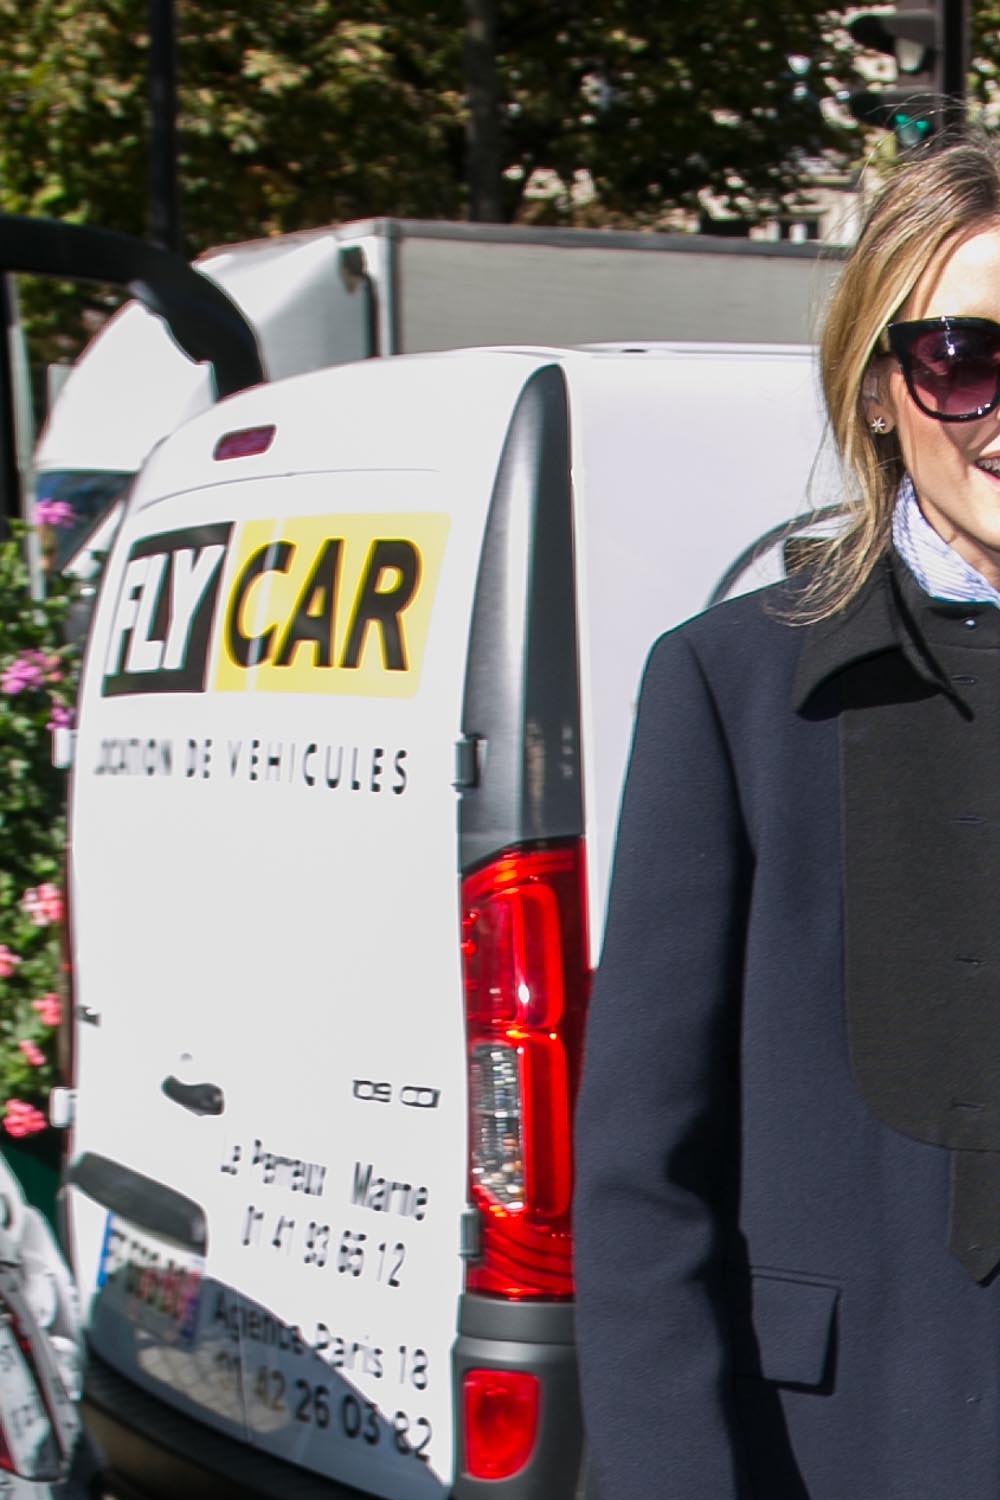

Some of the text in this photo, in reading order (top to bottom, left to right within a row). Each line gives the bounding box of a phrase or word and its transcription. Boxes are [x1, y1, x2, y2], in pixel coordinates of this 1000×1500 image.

[104, 537, 424, 676] FLY CAR
[185, 738, 213, 779] DE
[352, 1161, 429, 1222] Marne
[377, 1241, 407, 1288] 12
[214, 1291, 429, 1391] Agence Paris 18
[295, 1377, 330, 1430] 26
[393, 1410, 433, 1463] 82
